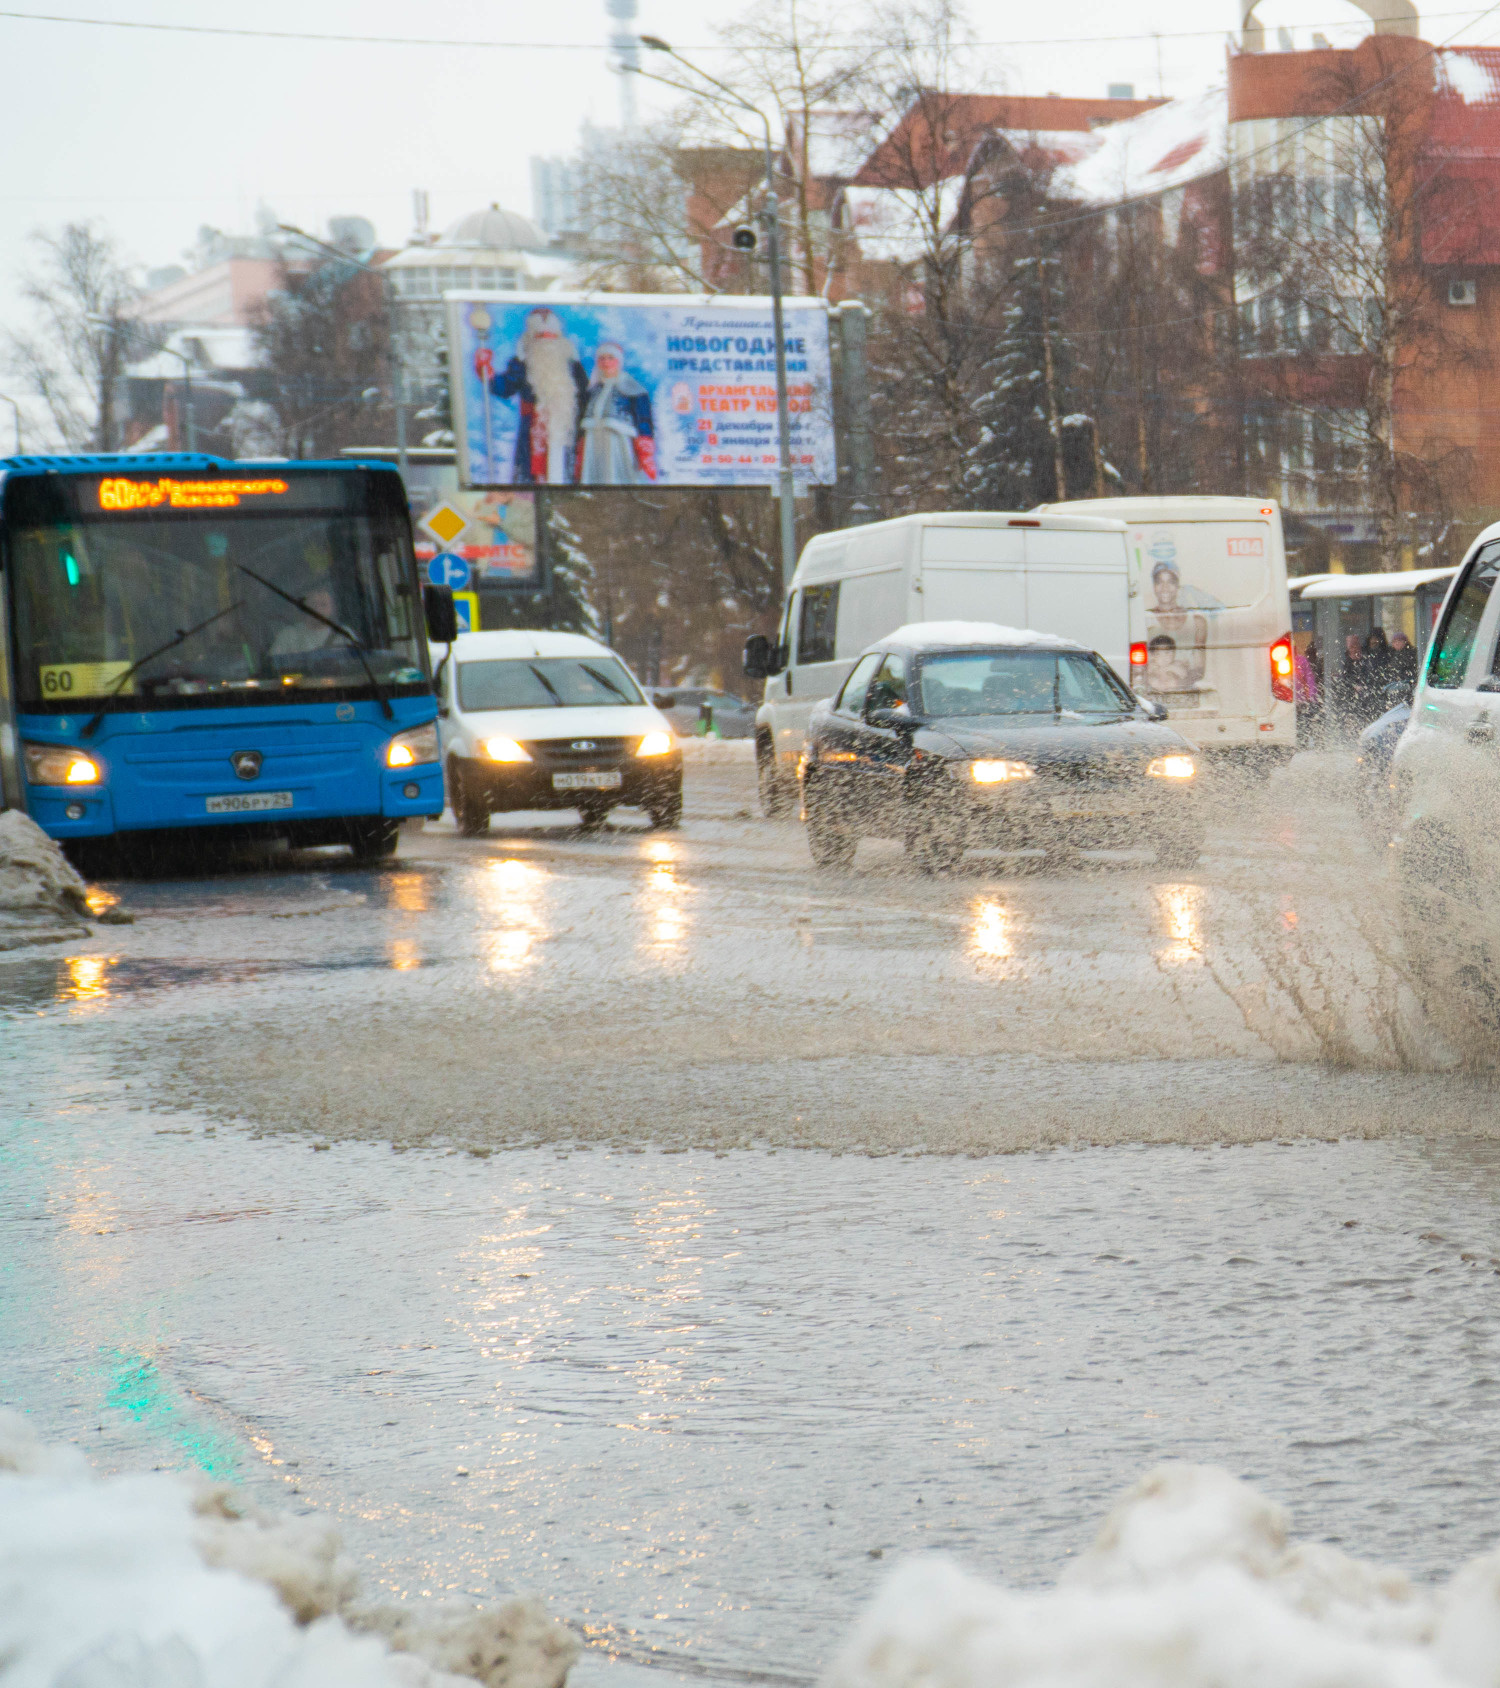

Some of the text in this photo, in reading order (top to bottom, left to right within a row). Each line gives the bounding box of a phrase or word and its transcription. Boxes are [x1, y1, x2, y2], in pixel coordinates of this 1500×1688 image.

[668, 359, 807, 374] ПРЕДСТАВЛЕИЯ
[699, 398, 812, 412] ТЕАТР КУОЛ
[698, 419, 712, 430] 21
[44, 671, 72, 692] 60
